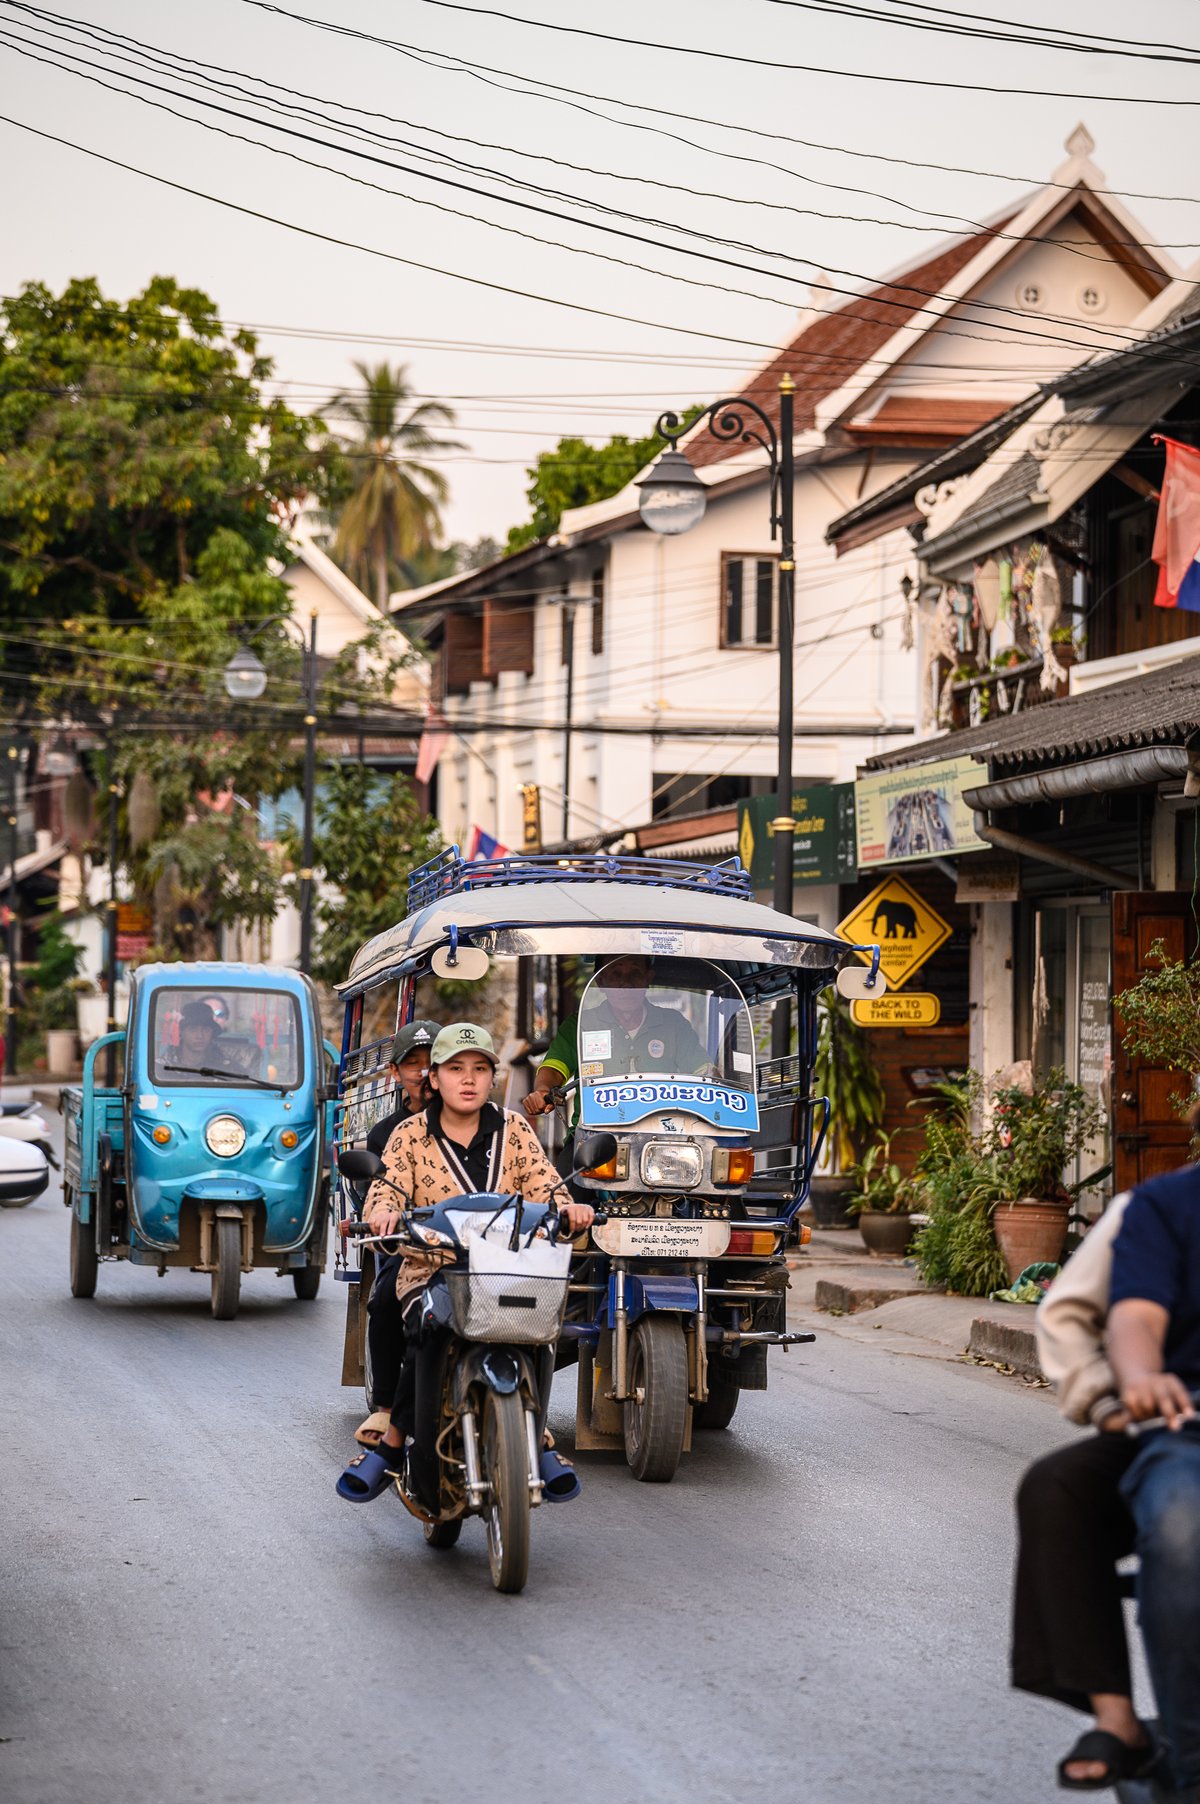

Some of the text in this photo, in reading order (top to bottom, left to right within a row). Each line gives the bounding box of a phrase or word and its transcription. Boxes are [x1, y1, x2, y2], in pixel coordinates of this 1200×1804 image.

[871, 1000, 920, 1009] BACK TO
[870, 1010, 922, 1019] THE WILD
[595, 1086, 748, 1112] ຫຼວງພະບາງ
[657, 1248, 667, 1256] 071
[678, 1249, 689, 1257] 418
